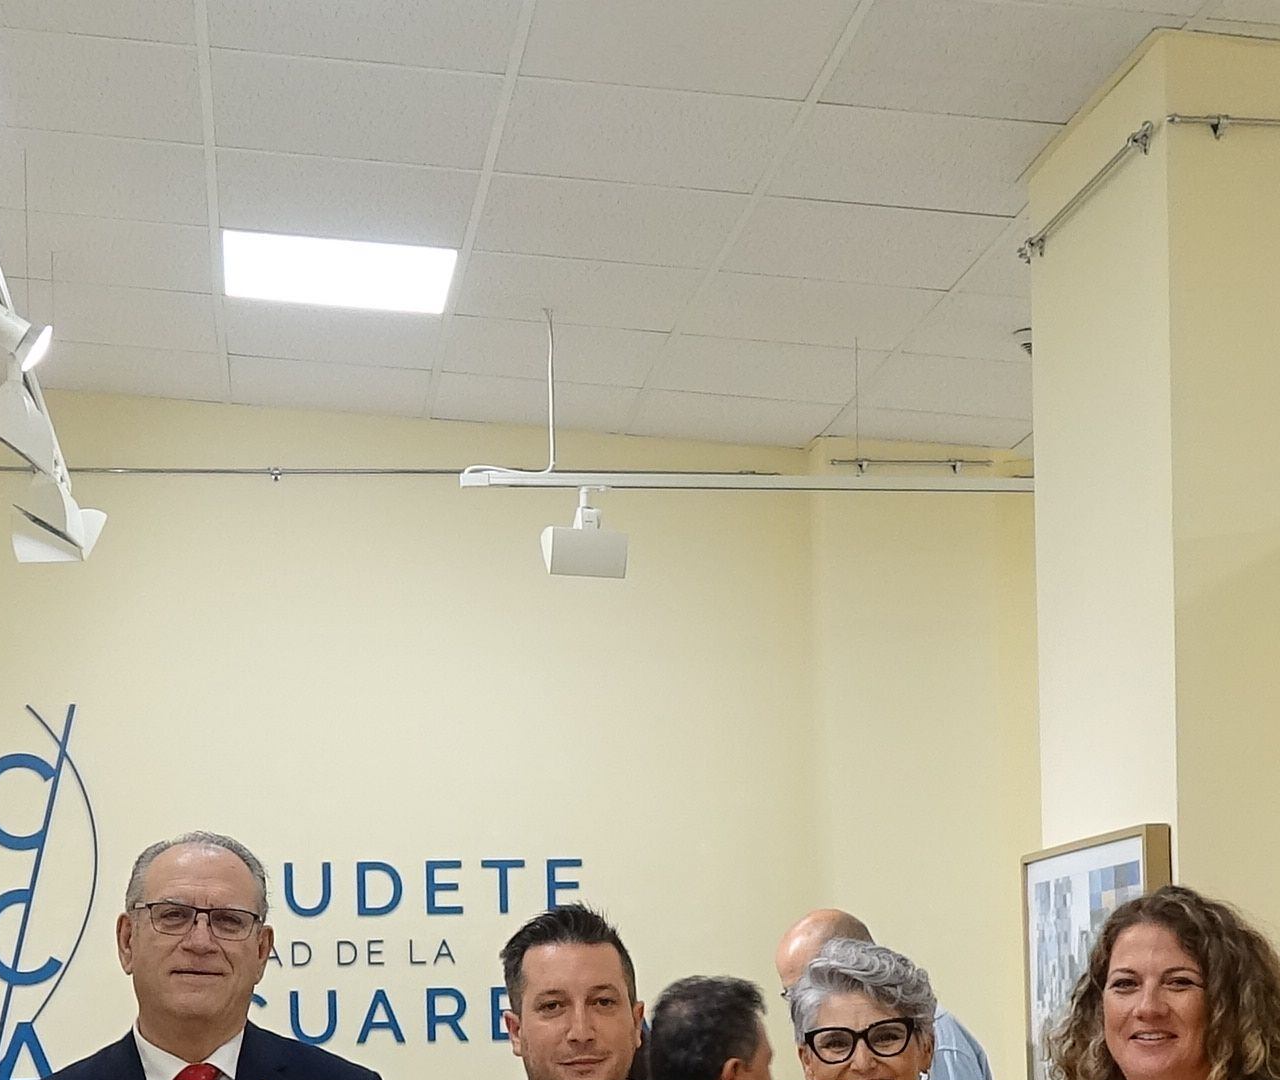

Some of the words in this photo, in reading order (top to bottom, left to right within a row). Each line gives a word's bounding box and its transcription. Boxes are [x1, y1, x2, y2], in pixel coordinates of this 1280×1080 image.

[283, 858, 583, 917] UDETE
[336, 939, 385, 966] DE
[409, 938, 456, 965] LA
